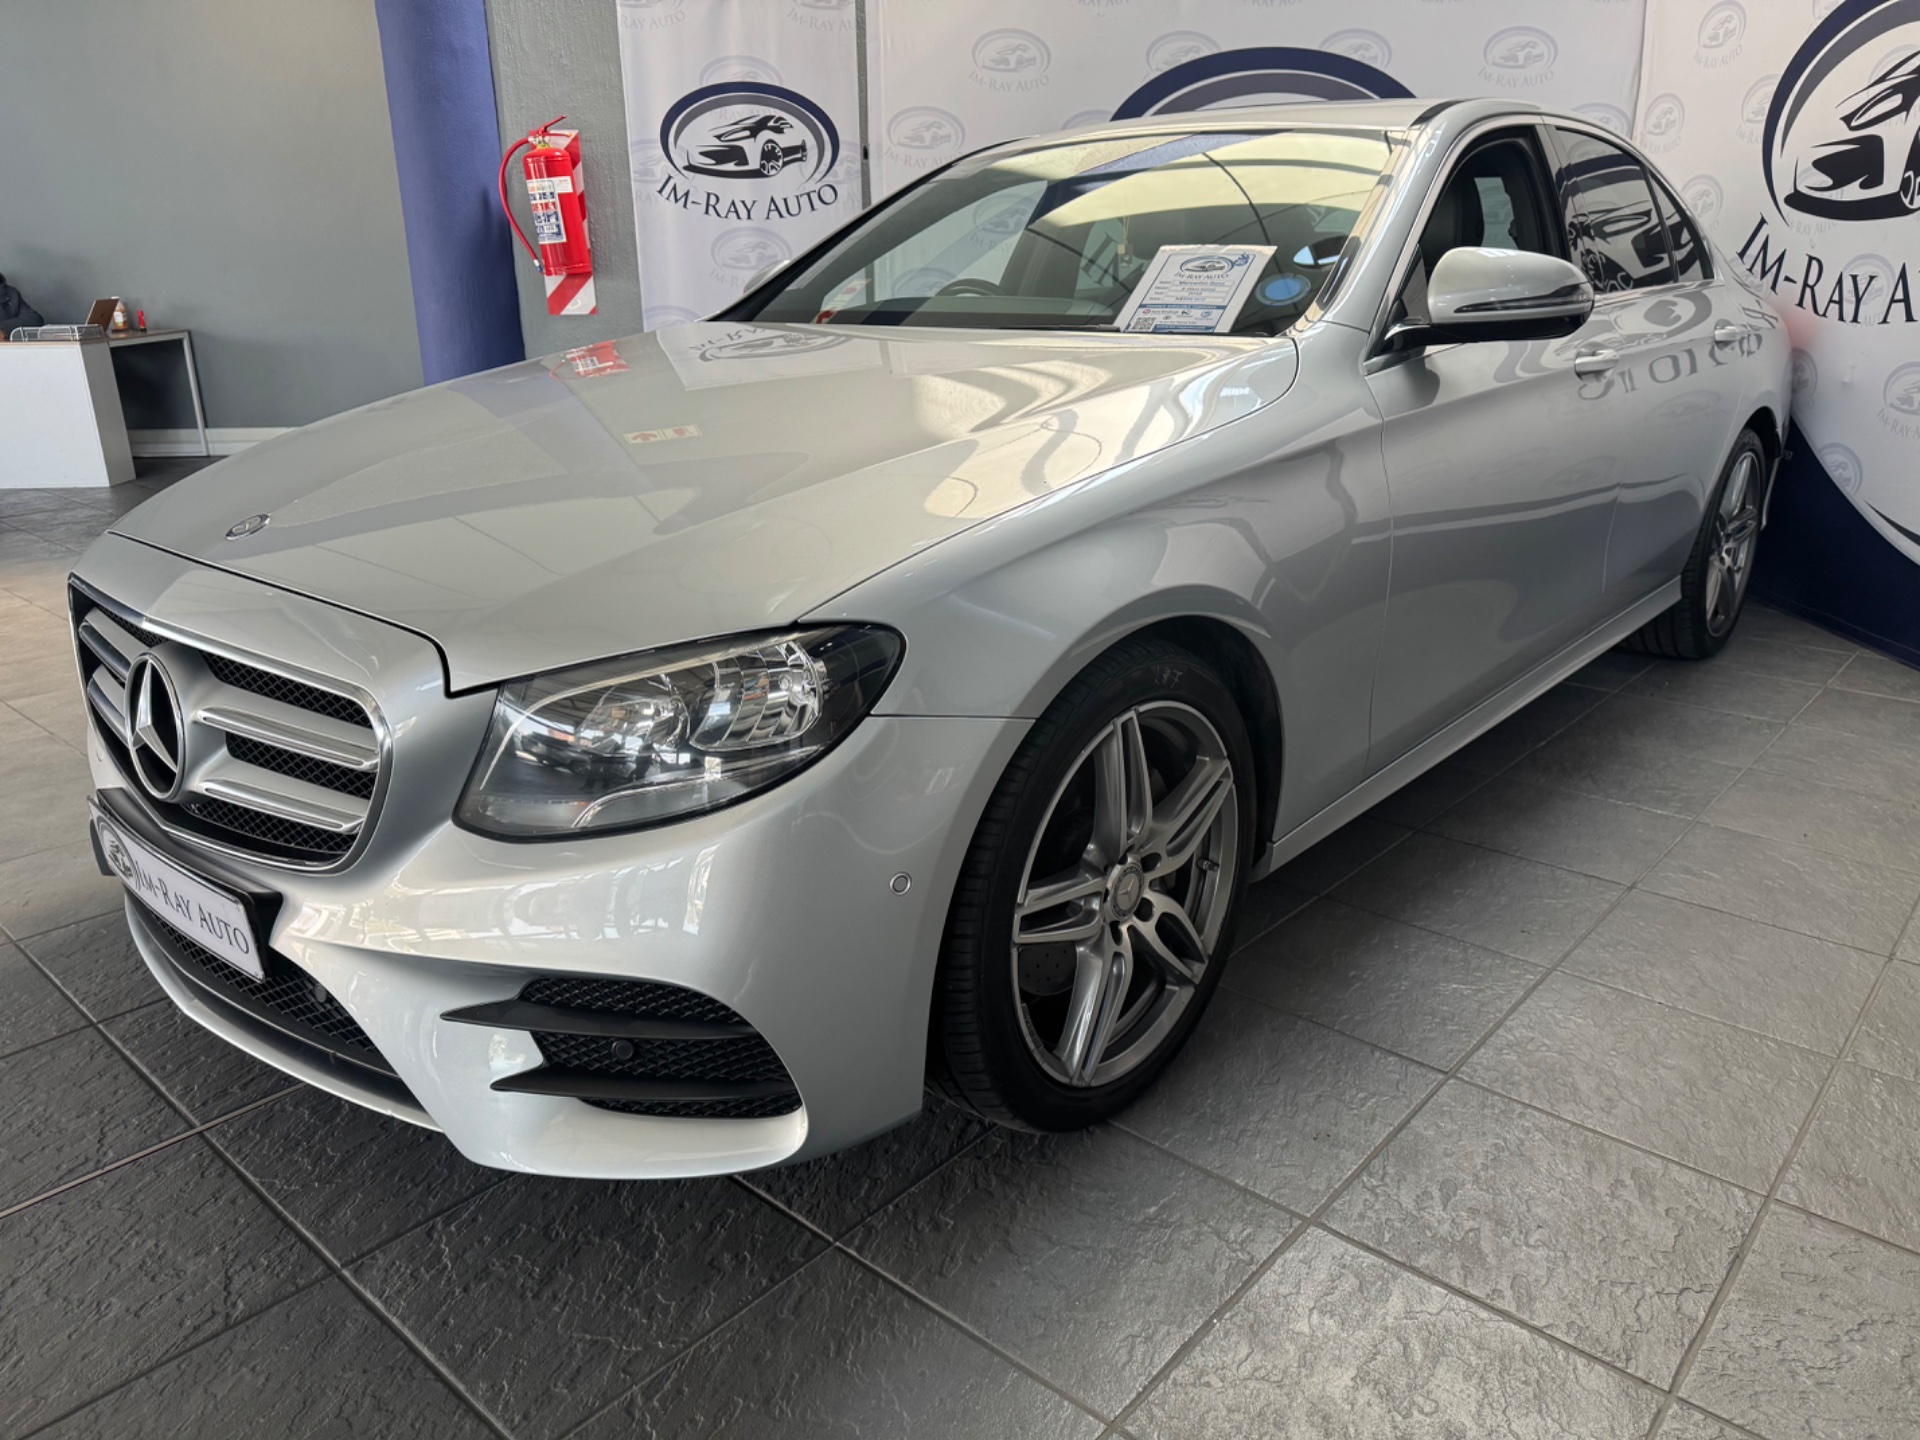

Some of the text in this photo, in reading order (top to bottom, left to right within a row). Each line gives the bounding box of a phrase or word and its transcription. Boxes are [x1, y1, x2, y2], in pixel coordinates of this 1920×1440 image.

[968, 69, 1050, 92] IM-RAY AUTO
[1478, 66, 1554, 88] IM-RAY AUTO
[656, 173, 758, 220] IM-RAY
[764, 183, 838, 220] AUTO
[1736, 212, 1920, 324] IM-RAY A
[138, 869, 250, 955] IM-RAY AUTO
